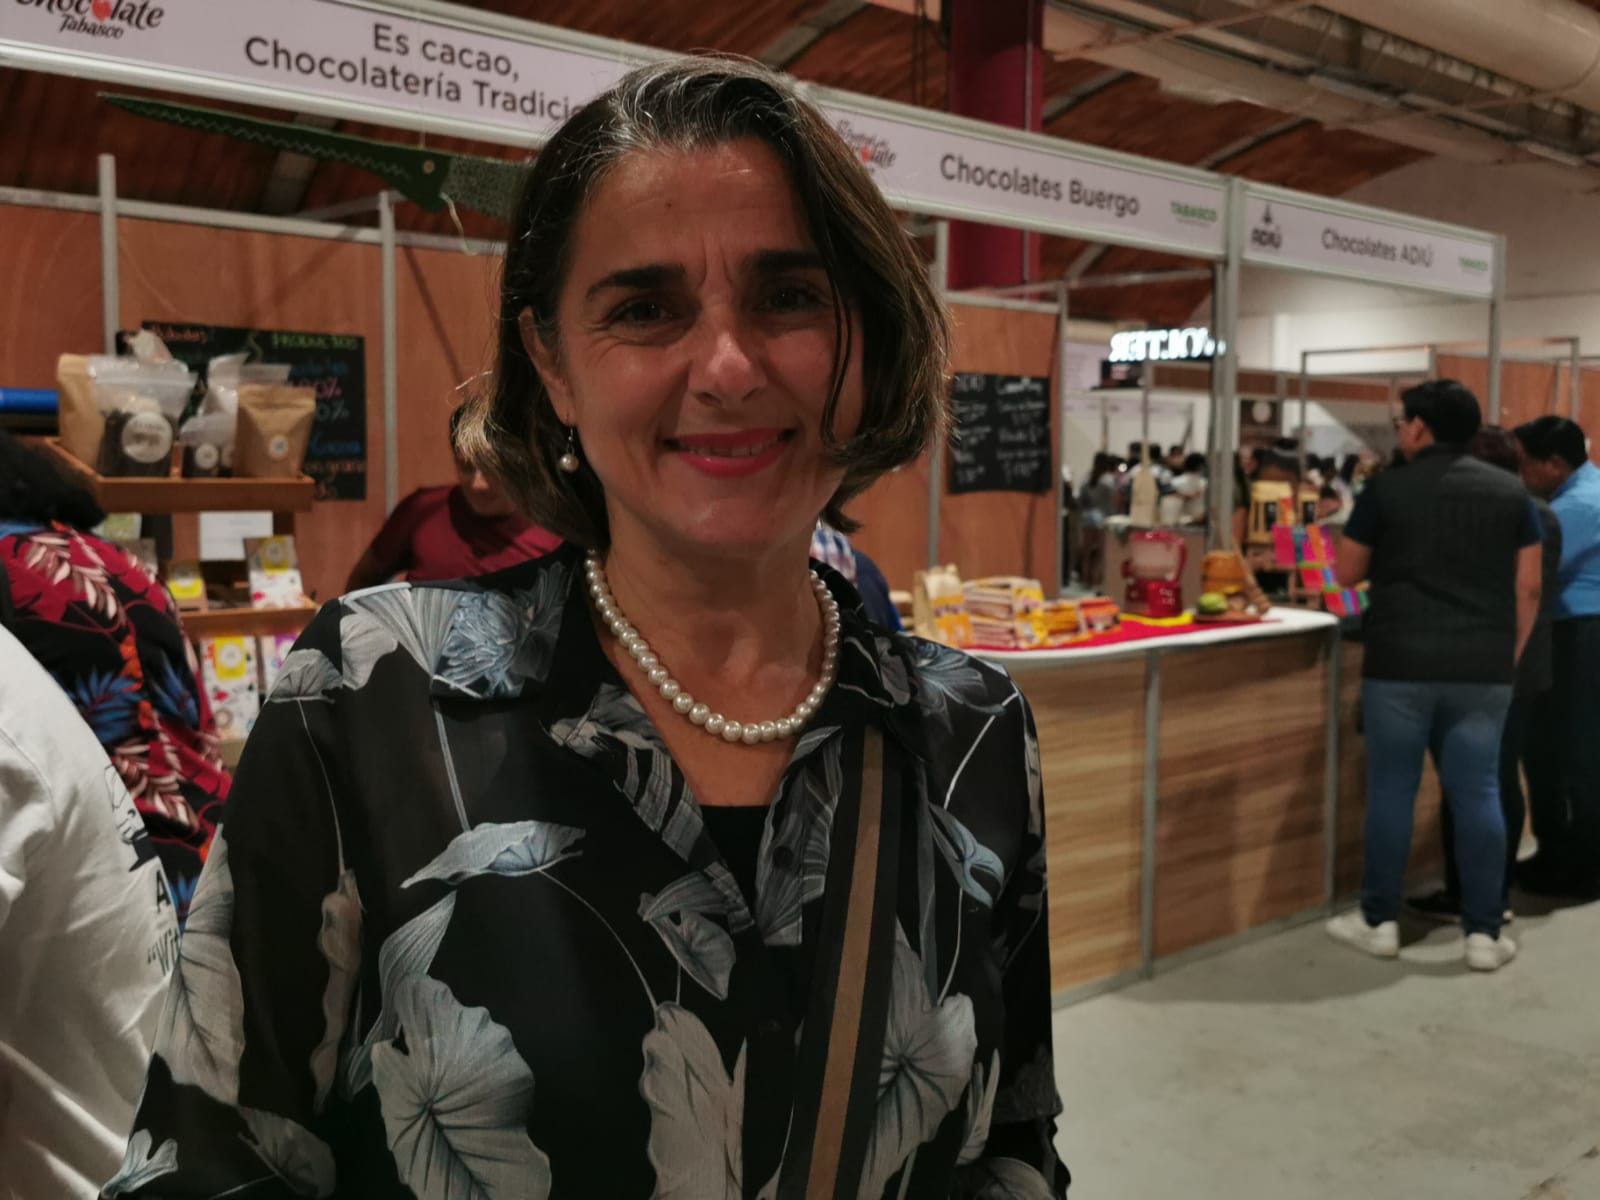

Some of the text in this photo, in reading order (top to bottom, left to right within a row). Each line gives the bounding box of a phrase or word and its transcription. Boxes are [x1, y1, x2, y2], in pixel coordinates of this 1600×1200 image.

[59, 14, 124, 39] Tabasco
[373, 23, 519, 82] Es cacao,
[245, 36, 462, 103] Chocolatería
[940, 154, 1140, 218] Chocolates Buergo
[1321, 227, 1397, 262] Chocolates
